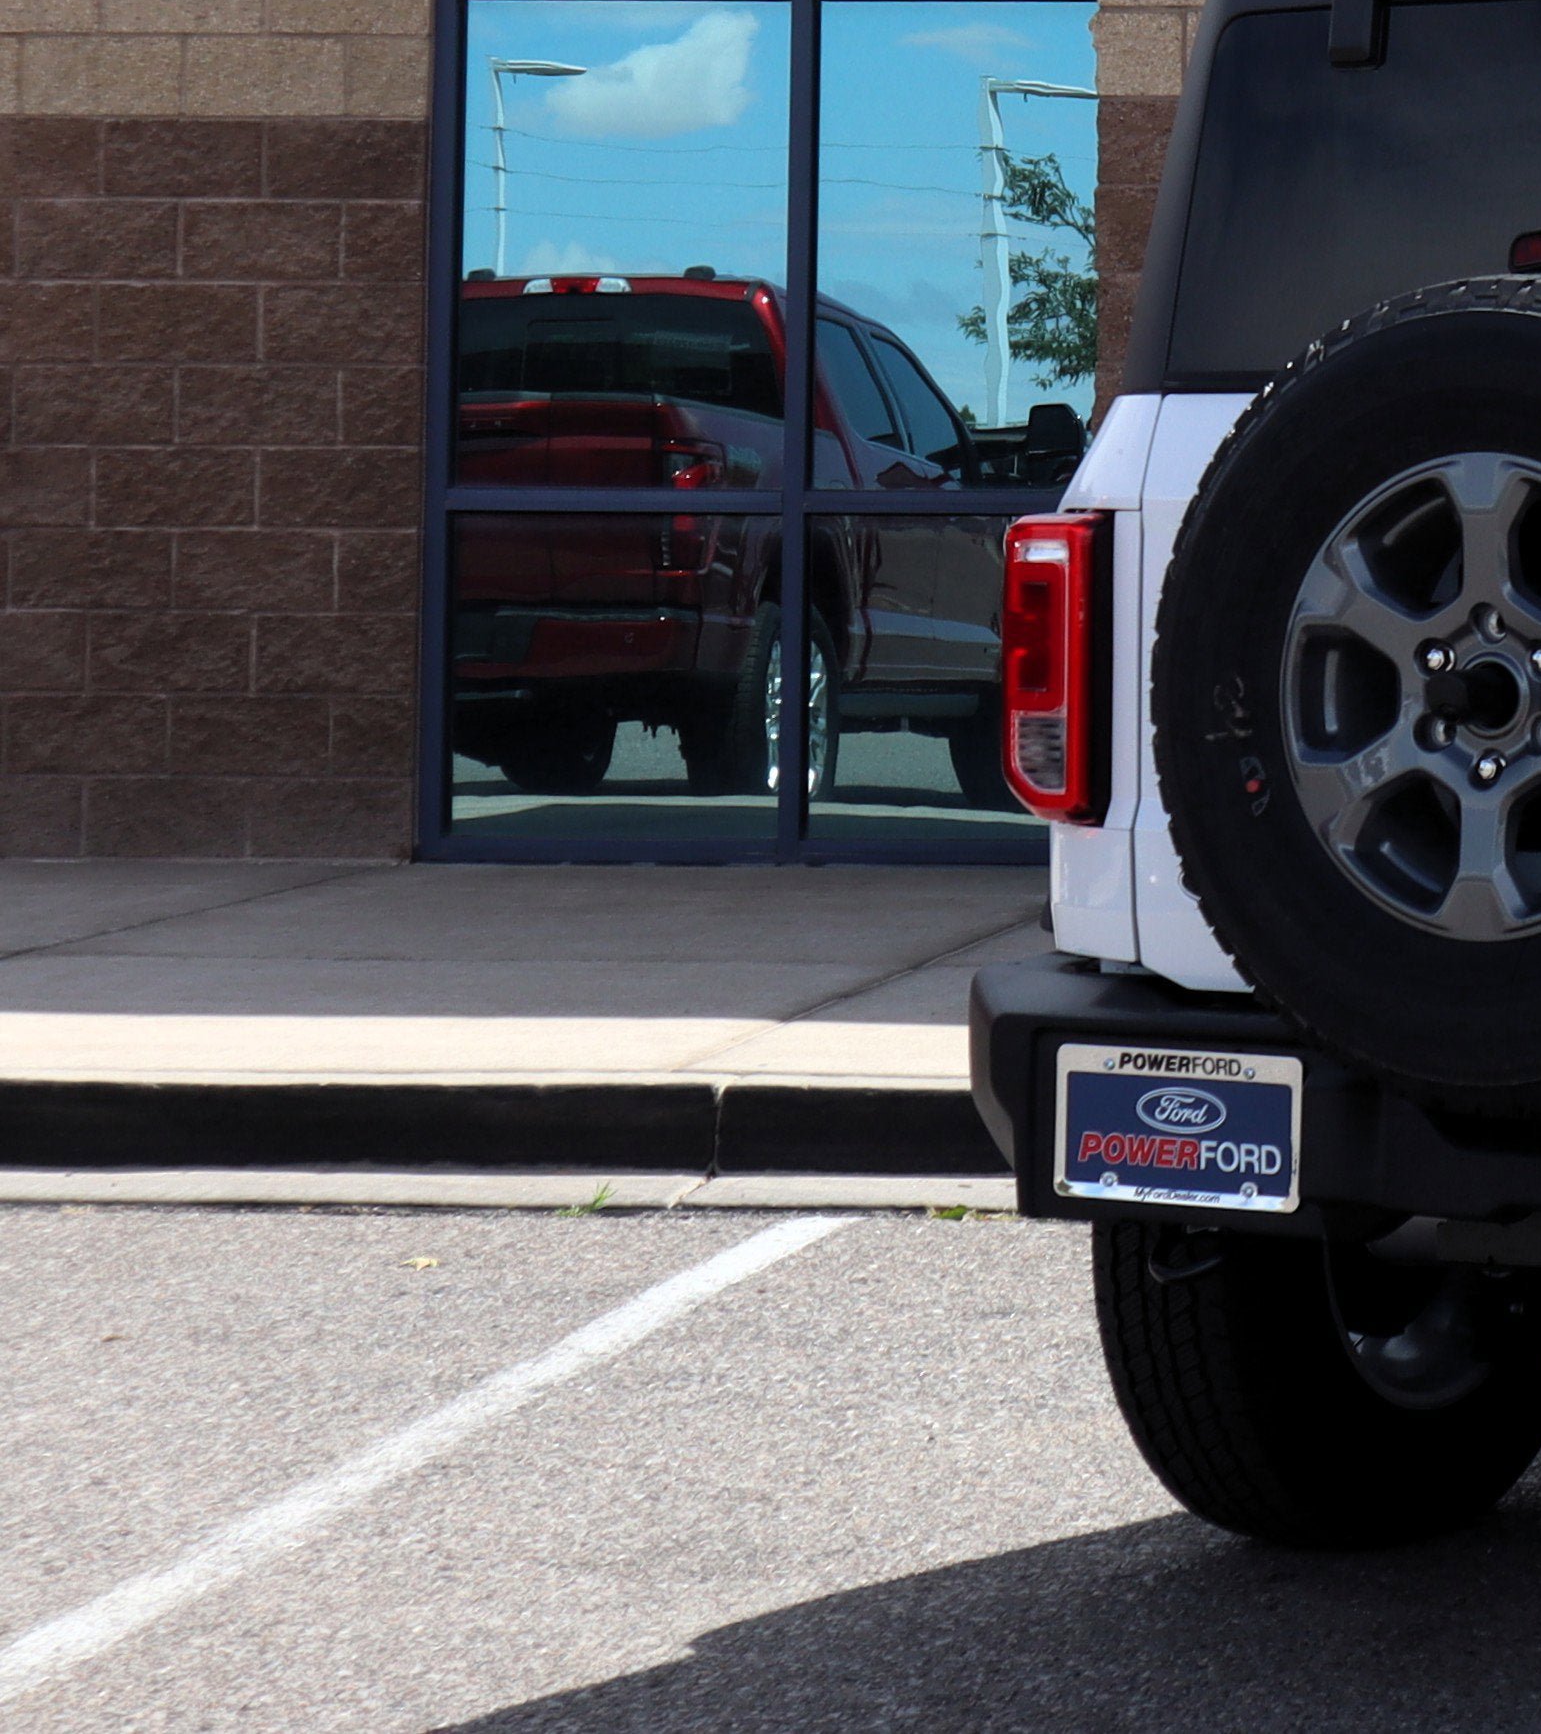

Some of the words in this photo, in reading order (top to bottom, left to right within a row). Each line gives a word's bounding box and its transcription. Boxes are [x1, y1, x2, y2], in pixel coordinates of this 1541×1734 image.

[1118, 1052, 1242, 1077] POWERFORD
[1154, 1094, 1209, 1124] Ford
[1078, 1131, 1282, 1175] POWERFORD
[1133, 1186, 1221, 1204] MyFordDealer.com
